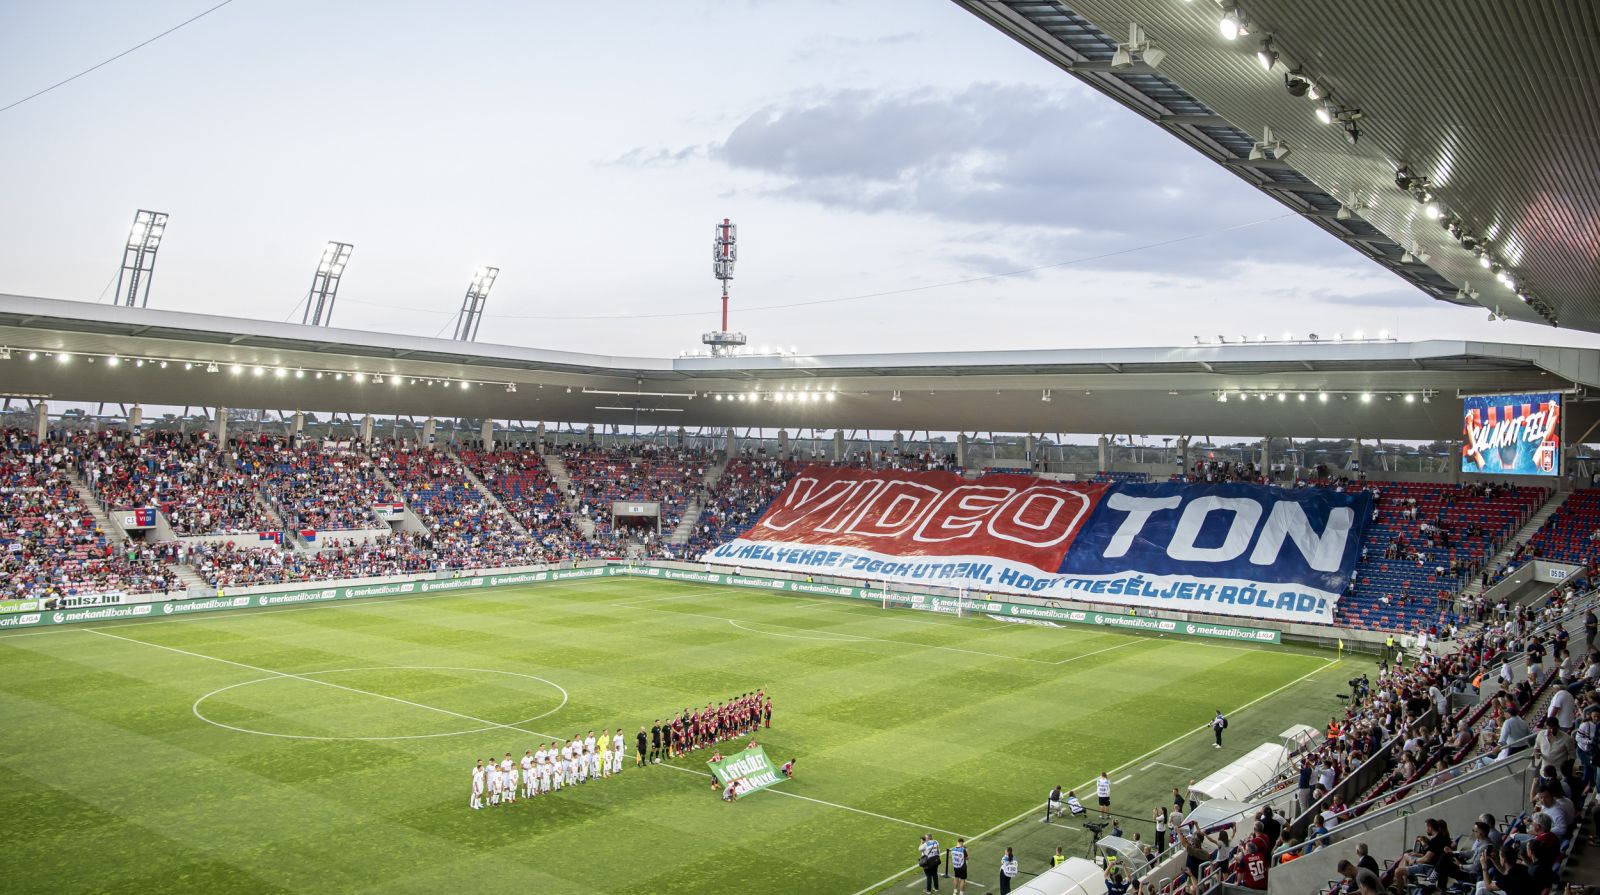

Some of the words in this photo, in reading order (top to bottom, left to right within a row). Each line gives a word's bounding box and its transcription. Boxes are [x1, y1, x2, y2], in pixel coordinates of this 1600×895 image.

[354, 586, 400, 596] merkantilbank
[268, 593, 321, 603] merkantilbank
[1217, 580, 1327, 615] RÓLAD!
[174, 600, 233, 612] merkantilbank
[21, 614, 39, 623] LIGA
[66, 608, 133, 621] merkantilbank
[134, 605, 150, 613] LIGA
[1020, 608, 1070, 619] merkantilbank
[1104, 616, 1159, 628] merkantilbank
[1197, 626, 1256, 638] merkantilbank
[1258, 632, 1274, 640] LIGA
[1248, 860, 1265, 877] 50
